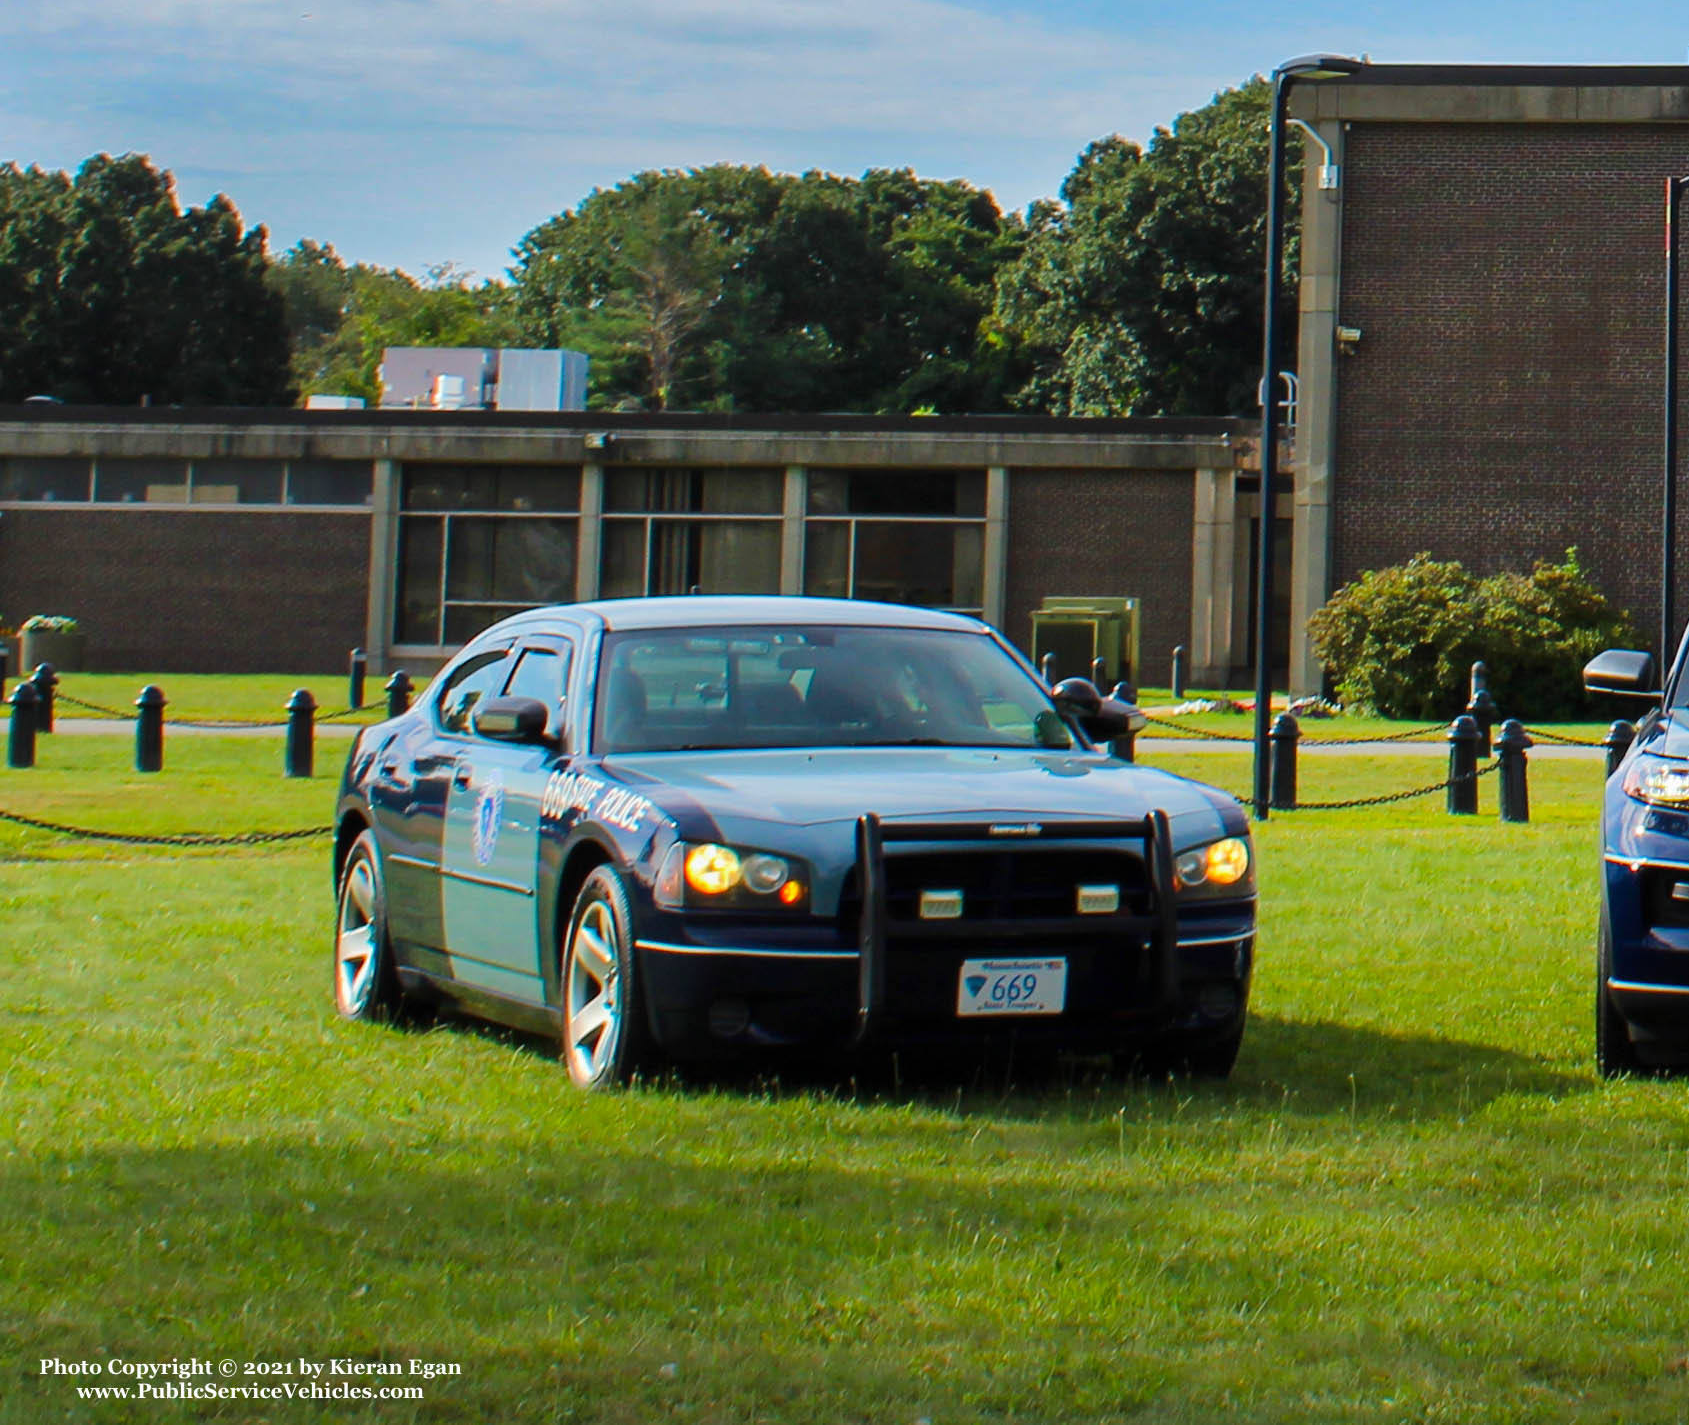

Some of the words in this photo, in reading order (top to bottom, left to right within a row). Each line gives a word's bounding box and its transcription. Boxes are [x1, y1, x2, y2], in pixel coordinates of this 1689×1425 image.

[542, 769, 576, 820] 669
[568, 773, 605, 812] STATE
[594, 786, 652, 832] POLICE
[991, 974, 1037, 1001] 669
